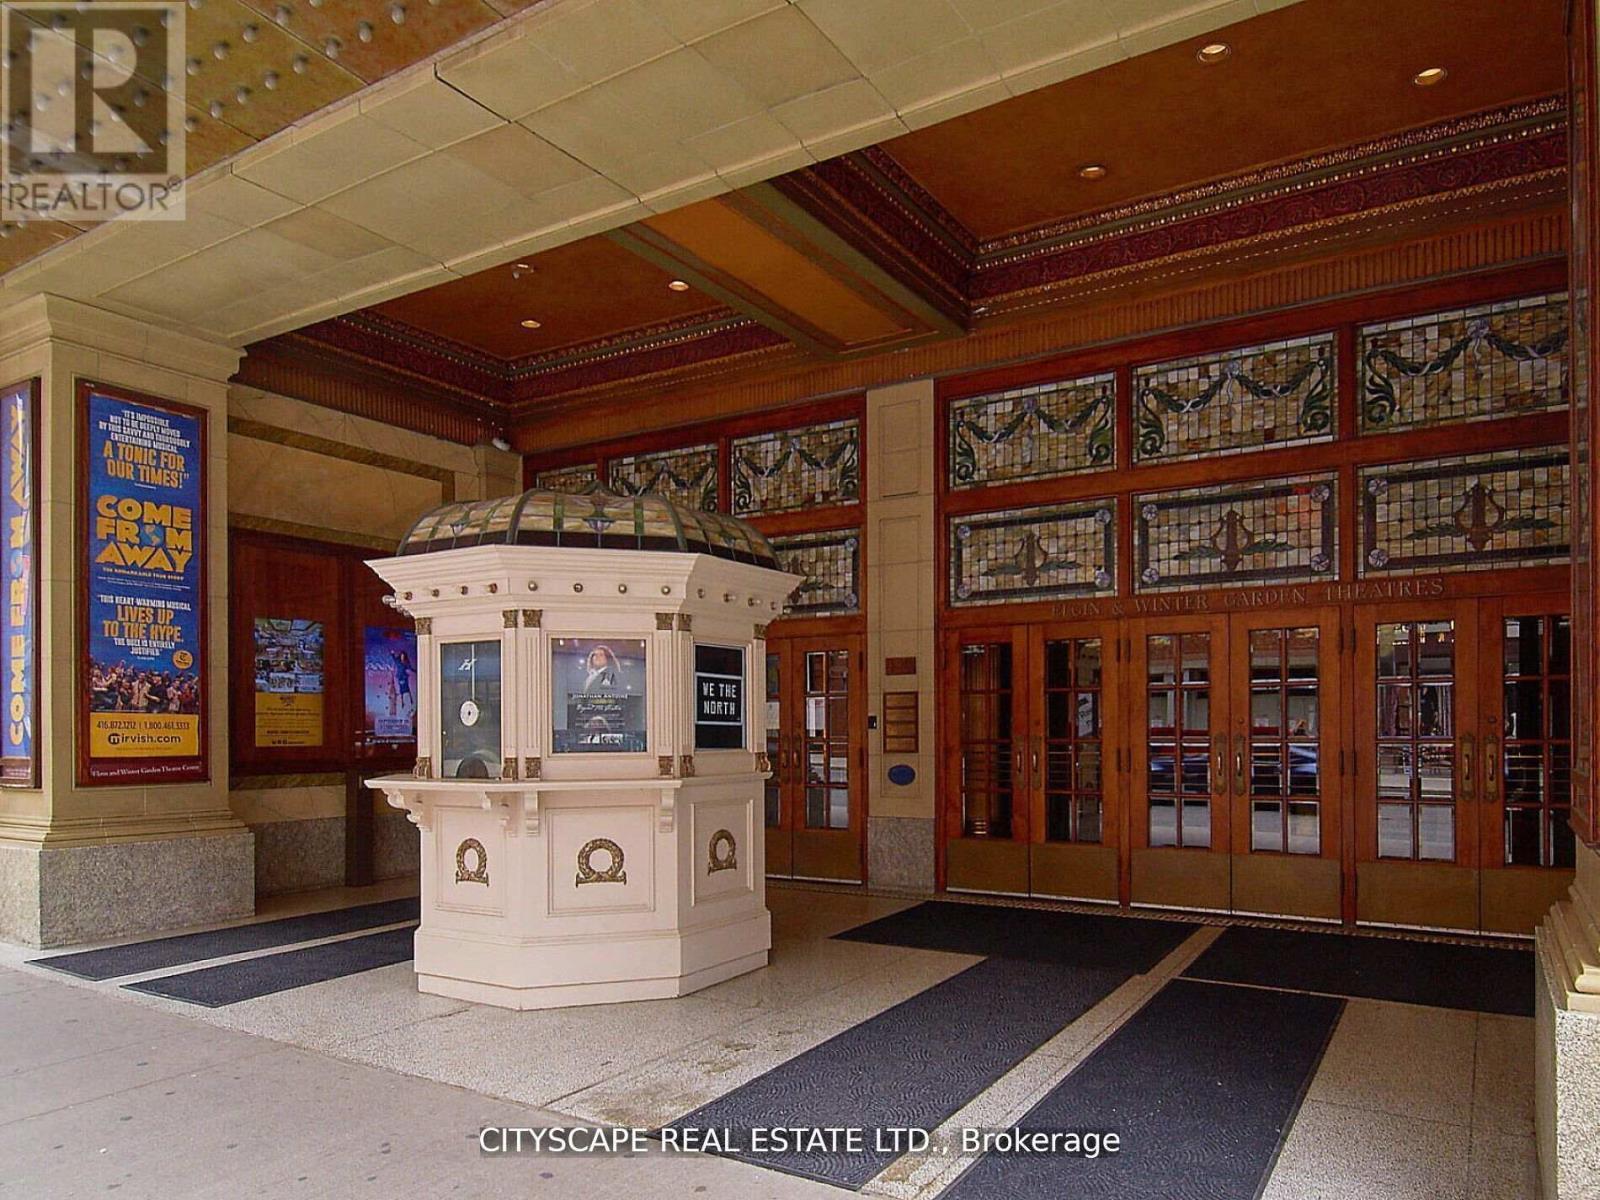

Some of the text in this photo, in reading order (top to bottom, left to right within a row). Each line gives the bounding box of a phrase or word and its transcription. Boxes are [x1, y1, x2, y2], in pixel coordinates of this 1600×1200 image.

[10, 404, 27, 510] AWAY
[103, 440, 185, 472] A TONIC FOR
[106, 458, 190, 489] OUR TIMES!"
[96, 494, 193, 530] COME
[94, 541, 193, 573] AWAY
[1052, 578, 1445, 617] ELGIN & WINTER GARDEN THEATRES
[117, 604, 175, 625] LIVES UP
[103, 620, 184, 643] TO THE HYPE.
[9, 635, 25, 745] COME
[718, 683, 737, 699] THE
[703, 700, 736, 716] NORTH
[107, 732, 181, 746] mirvish.com
